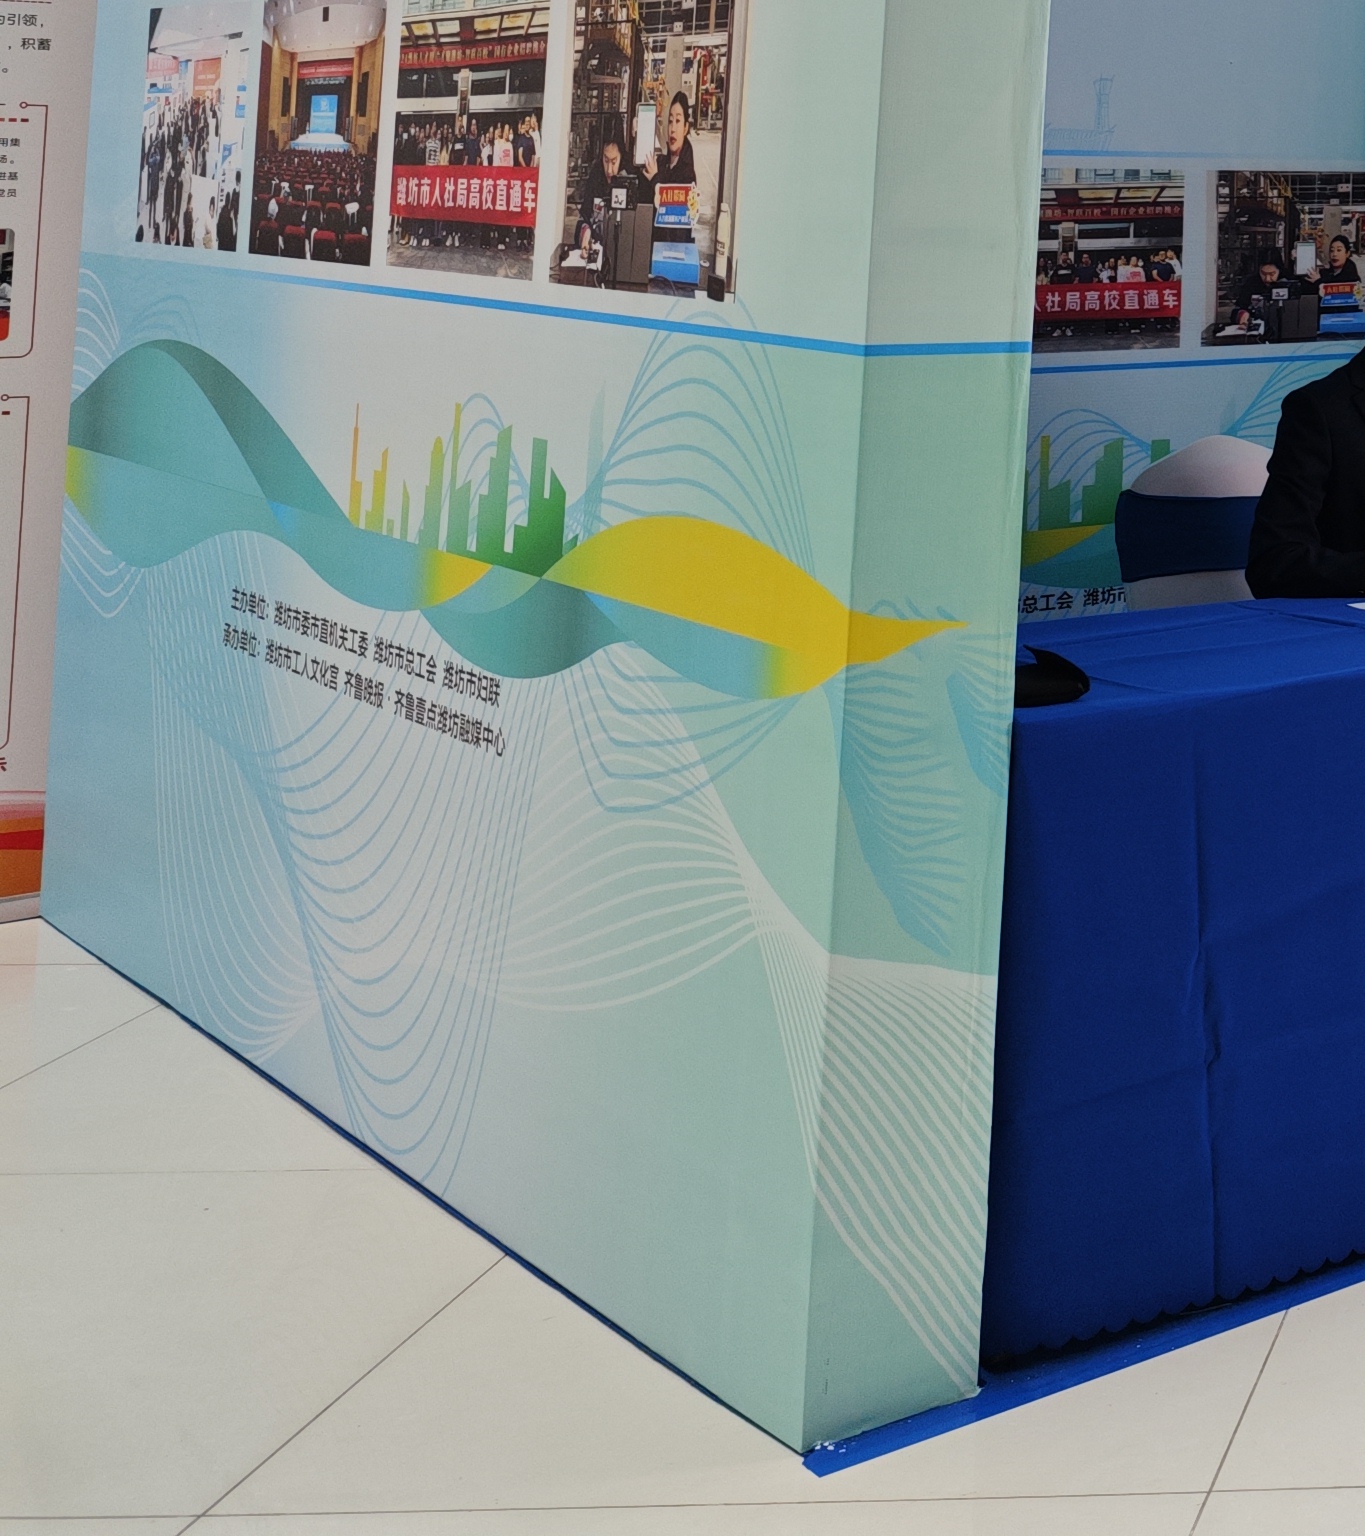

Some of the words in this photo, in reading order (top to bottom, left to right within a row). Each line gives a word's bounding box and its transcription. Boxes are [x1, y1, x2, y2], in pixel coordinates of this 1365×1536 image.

[1018, 591, 1074, 614] 总工会
[442, 659, 501, 709] 潍坊市妇联
